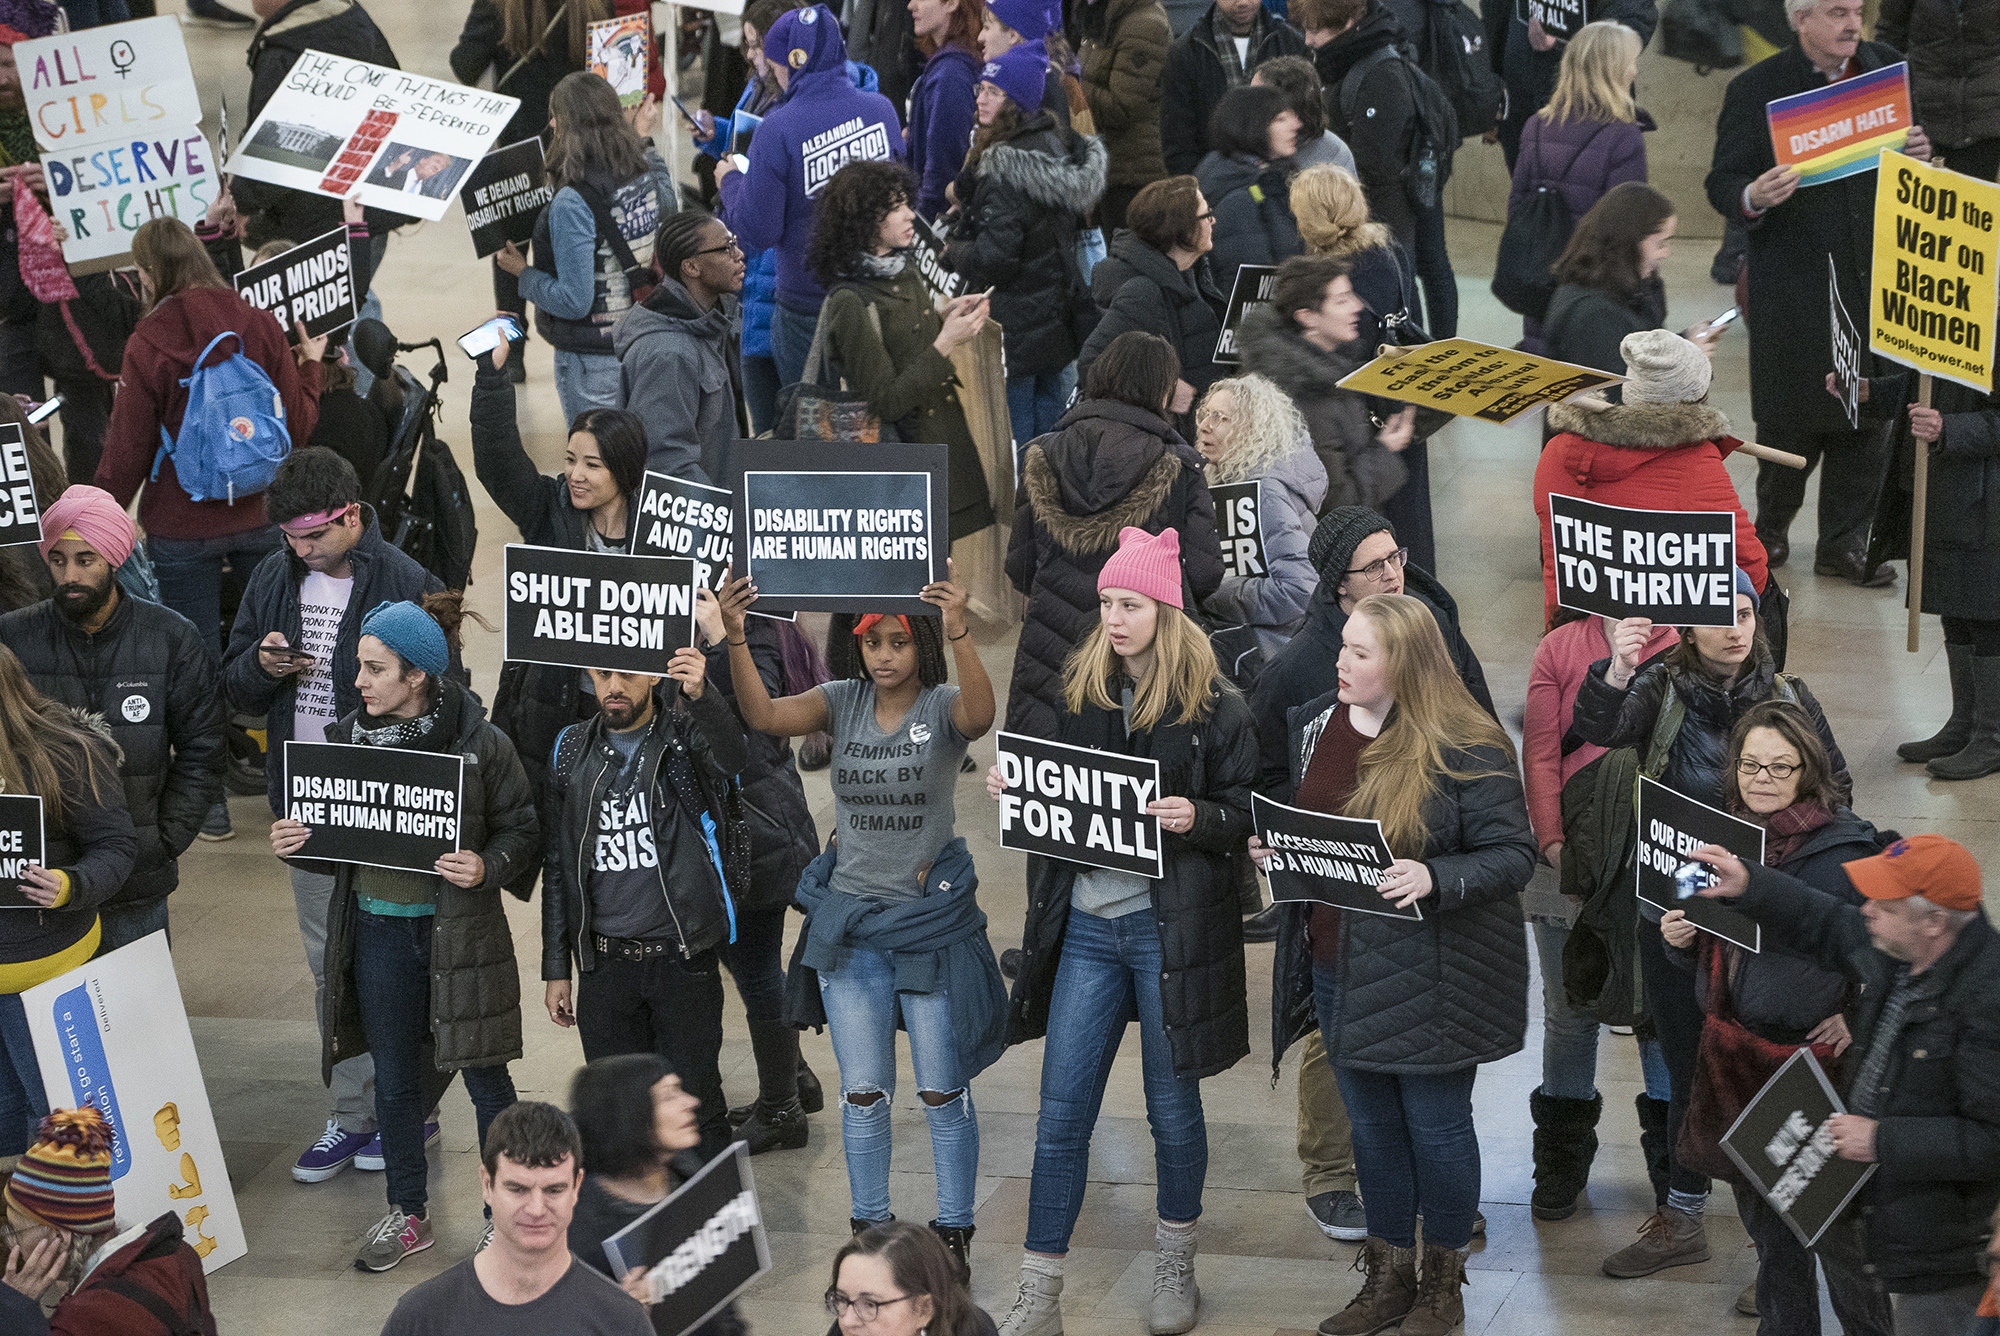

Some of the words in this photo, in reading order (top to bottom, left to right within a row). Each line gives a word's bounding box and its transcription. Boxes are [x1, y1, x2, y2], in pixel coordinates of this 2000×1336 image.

[1546, 7, 1567, 30] ALL
[34, 45, 96, 89] ALL
[299, 53, 339, 77] THE
[395, 77, 471, 106] THINGS
[473, 96, 512, 116] THAT
[287, 73, 357, 101] SHOULD
[373, 94, 398, 109] BE
[403, 103, 490, 136] SEPERATED
[802, 116, 864, 157] ALEXANDRIA
[1789, 118, 1853, 155] DISARM
[1855, 104, 1897, 133] HATE
[47, 135, 205, 196] DESERVE
[70, 179, 209, 239] RIGHTS
[466, 198, 513, 231] DISABILITY
[513, 184, 554, 213] RIGHTS
[474, 186, 489, 207] WE
[488, 172, 531, 202] DEMAND
[1897, 168, 1957, 220] Stop
[1962, 201, 1993, 232] the
[1897, 215, 1952, 262] War
[1958, 244, 1984, 275] on
[240, 273, 284, 309] OUR
[286, 243, 349, 296] MINDS
[1896, 258, 1971, 312] Black
[292, 275, 351, 322] PRIDE
[1882, 288, 1981, 352] Women
[1425, 350, 1459, 364] the
[1474, 350, 1499, 358] to
[753, 508, 853, 532] DISABILITY
[856, 509, 924, 533] RIGHTS
[1226, 497, 1256, 537] IS
[646, 521, 692, 553] AND
[751, 536, 788, 560] ARE
[791, 536, 857, 560] HUMAN
[861, 536, 928, 560] RIGHTS
[1554, 514, 1613, 561] THE
[1623, 530, 1731, 567] RIGHT
[509, 571, 591, 608] SHUT
[600, 580, 690, 616] DOWN
[1559, 553, 1598, 593] TO
[1604, 566, 1730, 606] THRIVE
[301, 604, 329, 615] BRONX
[302, 617, 325, 627] RONX
[533, 608, 664, 650] ABLEISM
[127, 698, 142, 706] ANTI
[310, 694, 329, 705] THE
[313, 682, 331, 692] THE
[124, 704, 146, 712] TRUMP
[308, 706, 327, 717] THE
[843, 741, 921, 760] FEMINIST
[293, 775, 390, 804] DISABILITY
[394, 784, 455, 814] RIGHTS
[838, 768, 887, 785] BACK
[898, 766, 924, 782] BY
[999, 750, 1155, 815] DIGNITY
[840, 792, 926, 806] POPULAR
[289, 801, 326, 825] ARE
[330, 803, 392, 832] HUMAN
[396, 811, 456, 841] RIGHTS
[850, 814, 923, 831] DEMAND
[1002, 793, 1076, 845] FOR
[1085, 813, 1158, 861] ALL
[1650, 818, 1675, 850] OUR
[594, 827, 658, 872] ESIS
[1266, 829, 1380, 864] ACCESSIBILITY
[1640, 841, 1651, 866] IS
[1653, 849, 1677, 877] OUR
[1265, 852, 1285, 872] IS
[1285, 852, 1301, 873] A
[1298, 854, 1358, 883] HUMAN
[63, 1011, 71, 1021] a
[93, 978, 110, 1033] Delivered
[65, 1024, 83, 1063] start
[78, 1067, 91, 1088] go
